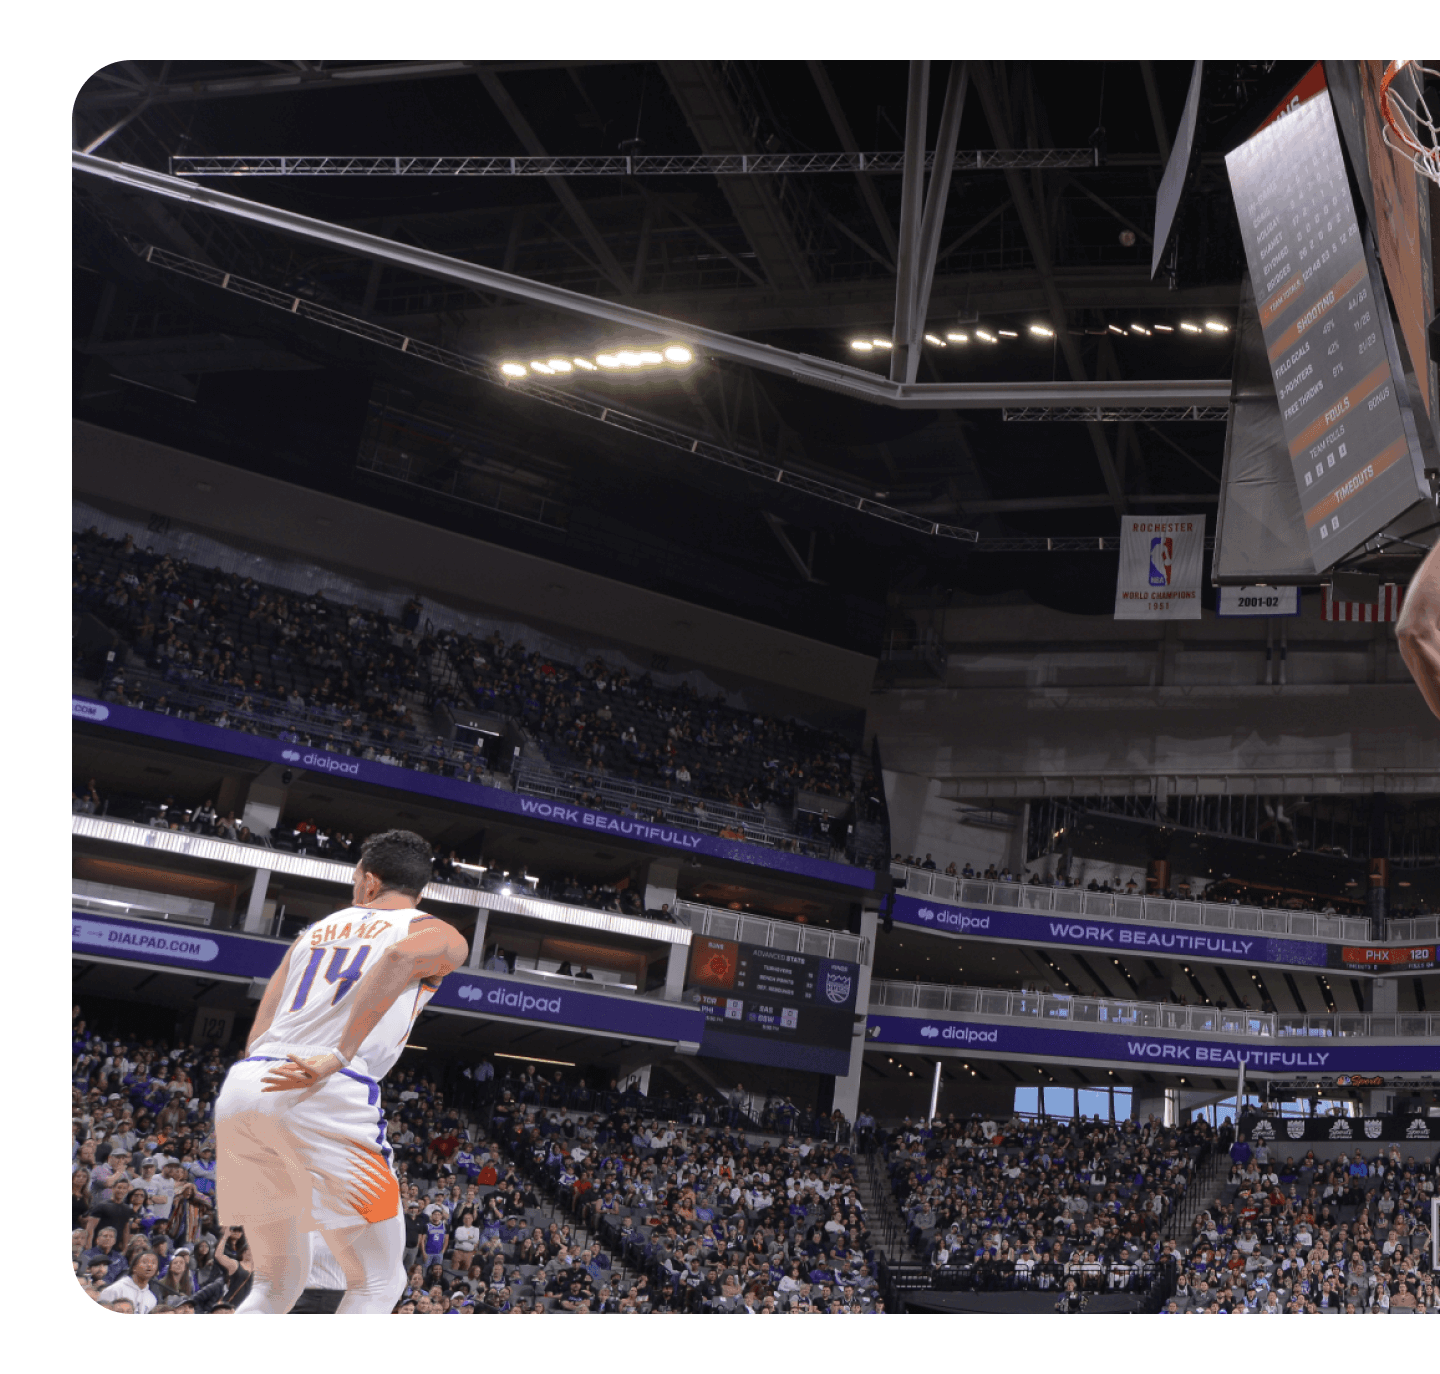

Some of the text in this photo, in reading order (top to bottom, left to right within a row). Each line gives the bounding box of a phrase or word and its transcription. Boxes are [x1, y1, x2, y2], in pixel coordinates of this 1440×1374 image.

[1297, 290, 1336, 334] SHOOTING
[1275, 358, 1292, 380] FIELD
[1292, 341, 1310, 365] GOALS
[1279, 364, 1314, 400] 3-POINTERS
[1284, 400, 1300, 421] FREE
[1298, 380, 1324, 407] THROWS
[1324, 397, 1350, 426] FOULS
[1309, 424, 1345, 459] TEAM FOULS
[1335, 464, 1374, 503] TIMEOUTS
[1132, 522, 1194, 532] ROCHESTER
[1150, 576, 1165, 584] NBA
[1122, 590, 1196, 600] WORLD CHAMPIONS
[1148, 602, 1170, 610] 1951
[1238, 596, 1279, 608] 2001-02
[304, 752, 360, 776] dialpad
[520, 798, 702, 849] WORK BEAUTIFULLY
[936, 910, 990, 930] dialpad
[108, 930, 201, 955] DIALPAD.COM
[1050, 922, 1254, 955] WORK BEAUTIFULLY
[1366, 950, 1390, 960] PHX
[1410, 948, 1430, 960] 120
[288, 944, 372, 1013] 14
[487, 988, 562, 1014] dialpad
[202, 1016, 226, 1038] 123
[942, 1024, 998, 1044] dialpad
[1127, 1041, 1191, 1060] WORK
[1195, 1046, 1330, 1067] BEAUTIFULLY
